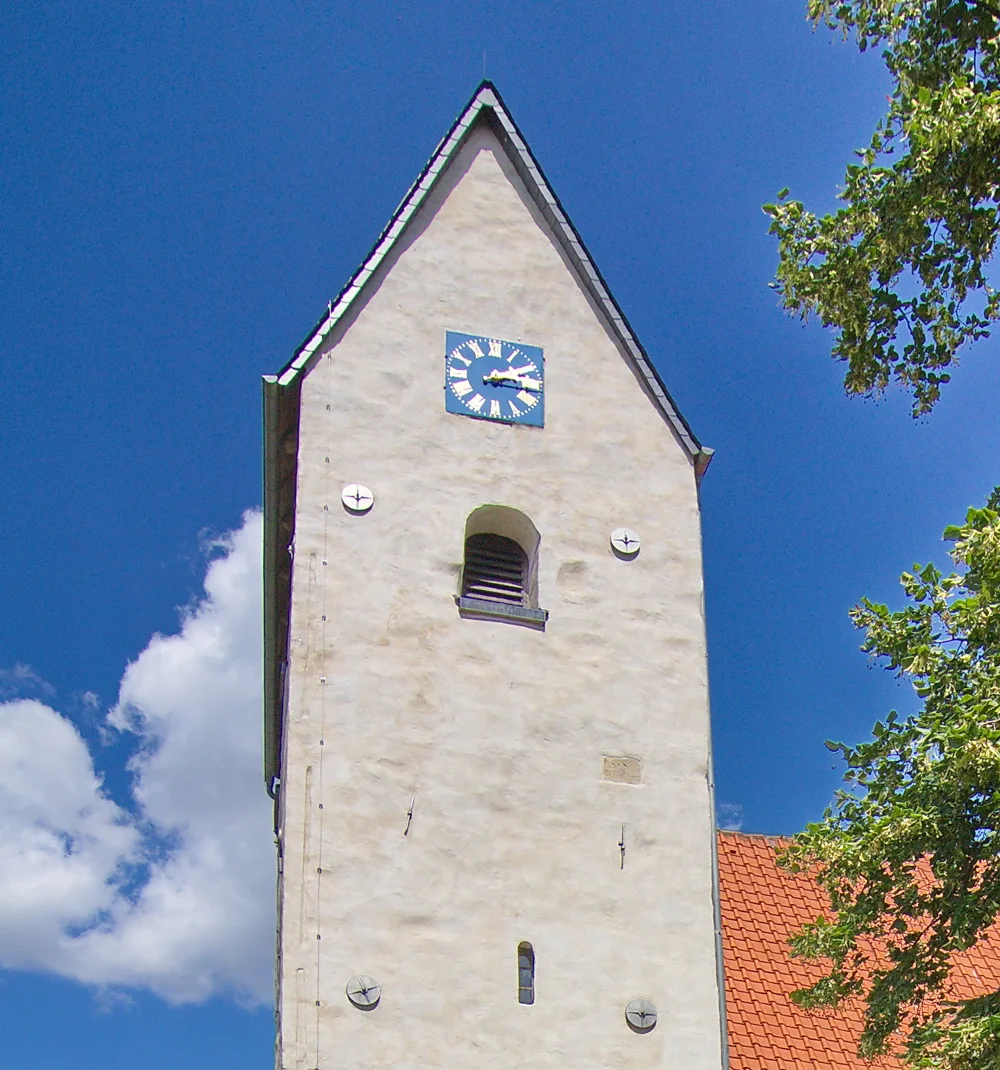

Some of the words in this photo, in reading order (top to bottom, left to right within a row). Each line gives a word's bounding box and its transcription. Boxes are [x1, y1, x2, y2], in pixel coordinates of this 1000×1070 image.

[453, 350, 472, 367] X
[506, 350, 519, 363] I
[508, 400, 520, 416] V
